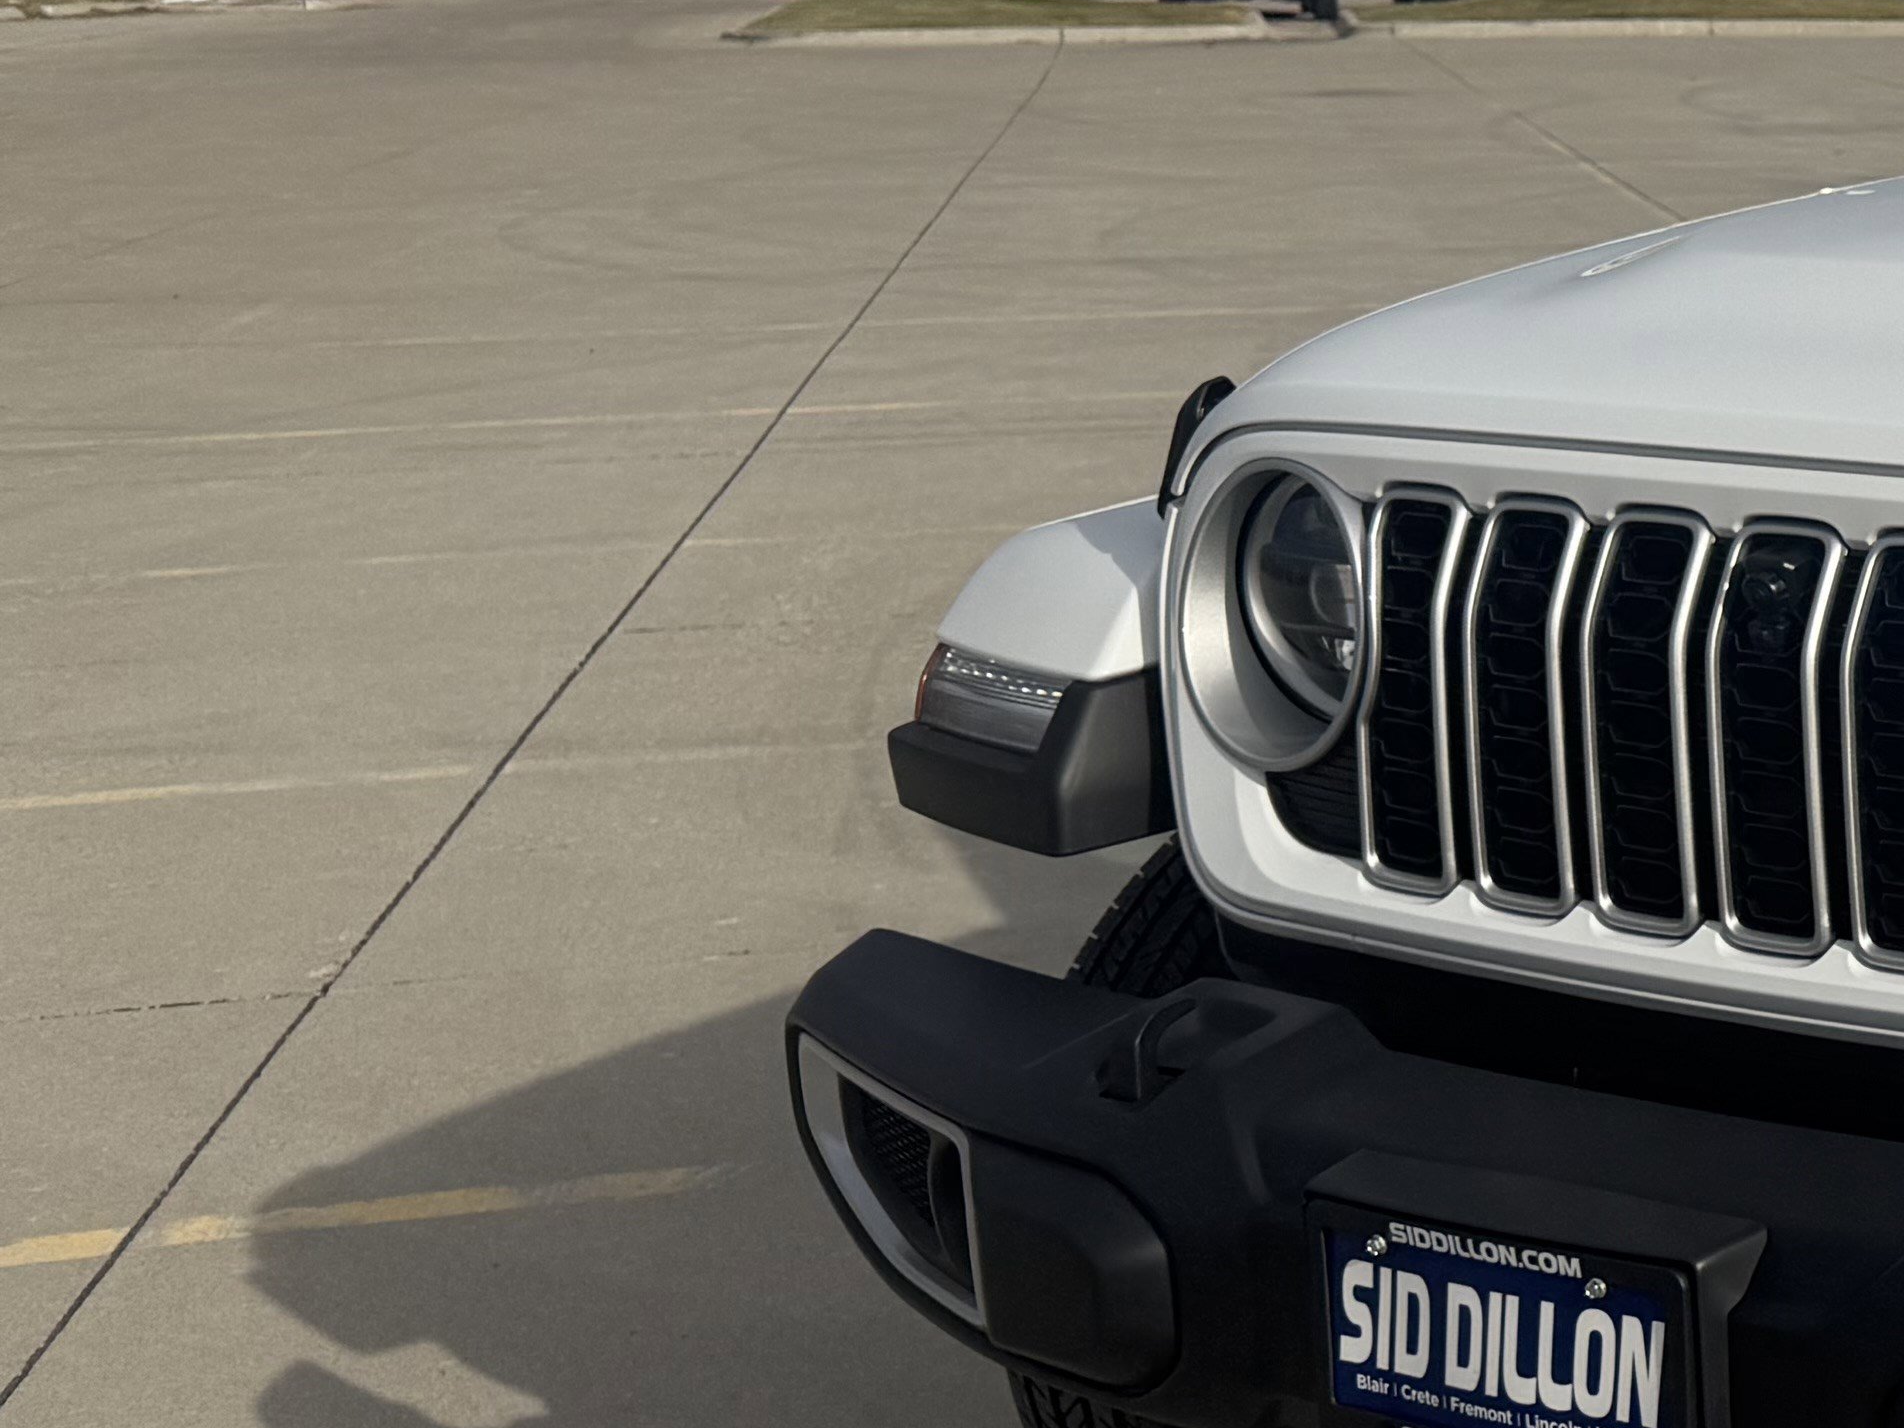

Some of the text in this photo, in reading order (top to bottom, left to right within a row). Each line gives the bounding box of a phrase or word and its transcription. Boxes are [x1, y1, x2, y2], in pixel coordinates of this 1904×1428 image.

[1388, 1222, 1582, 1279] SIDDILLON.COM
[1339, 1259, 1431, 1379] SID
[1355, 1373, 1390, 1396] Blair
[1400, 1384, 1440, 1408] Crete
[1450, 1396, 1513, 1426] Fremont
